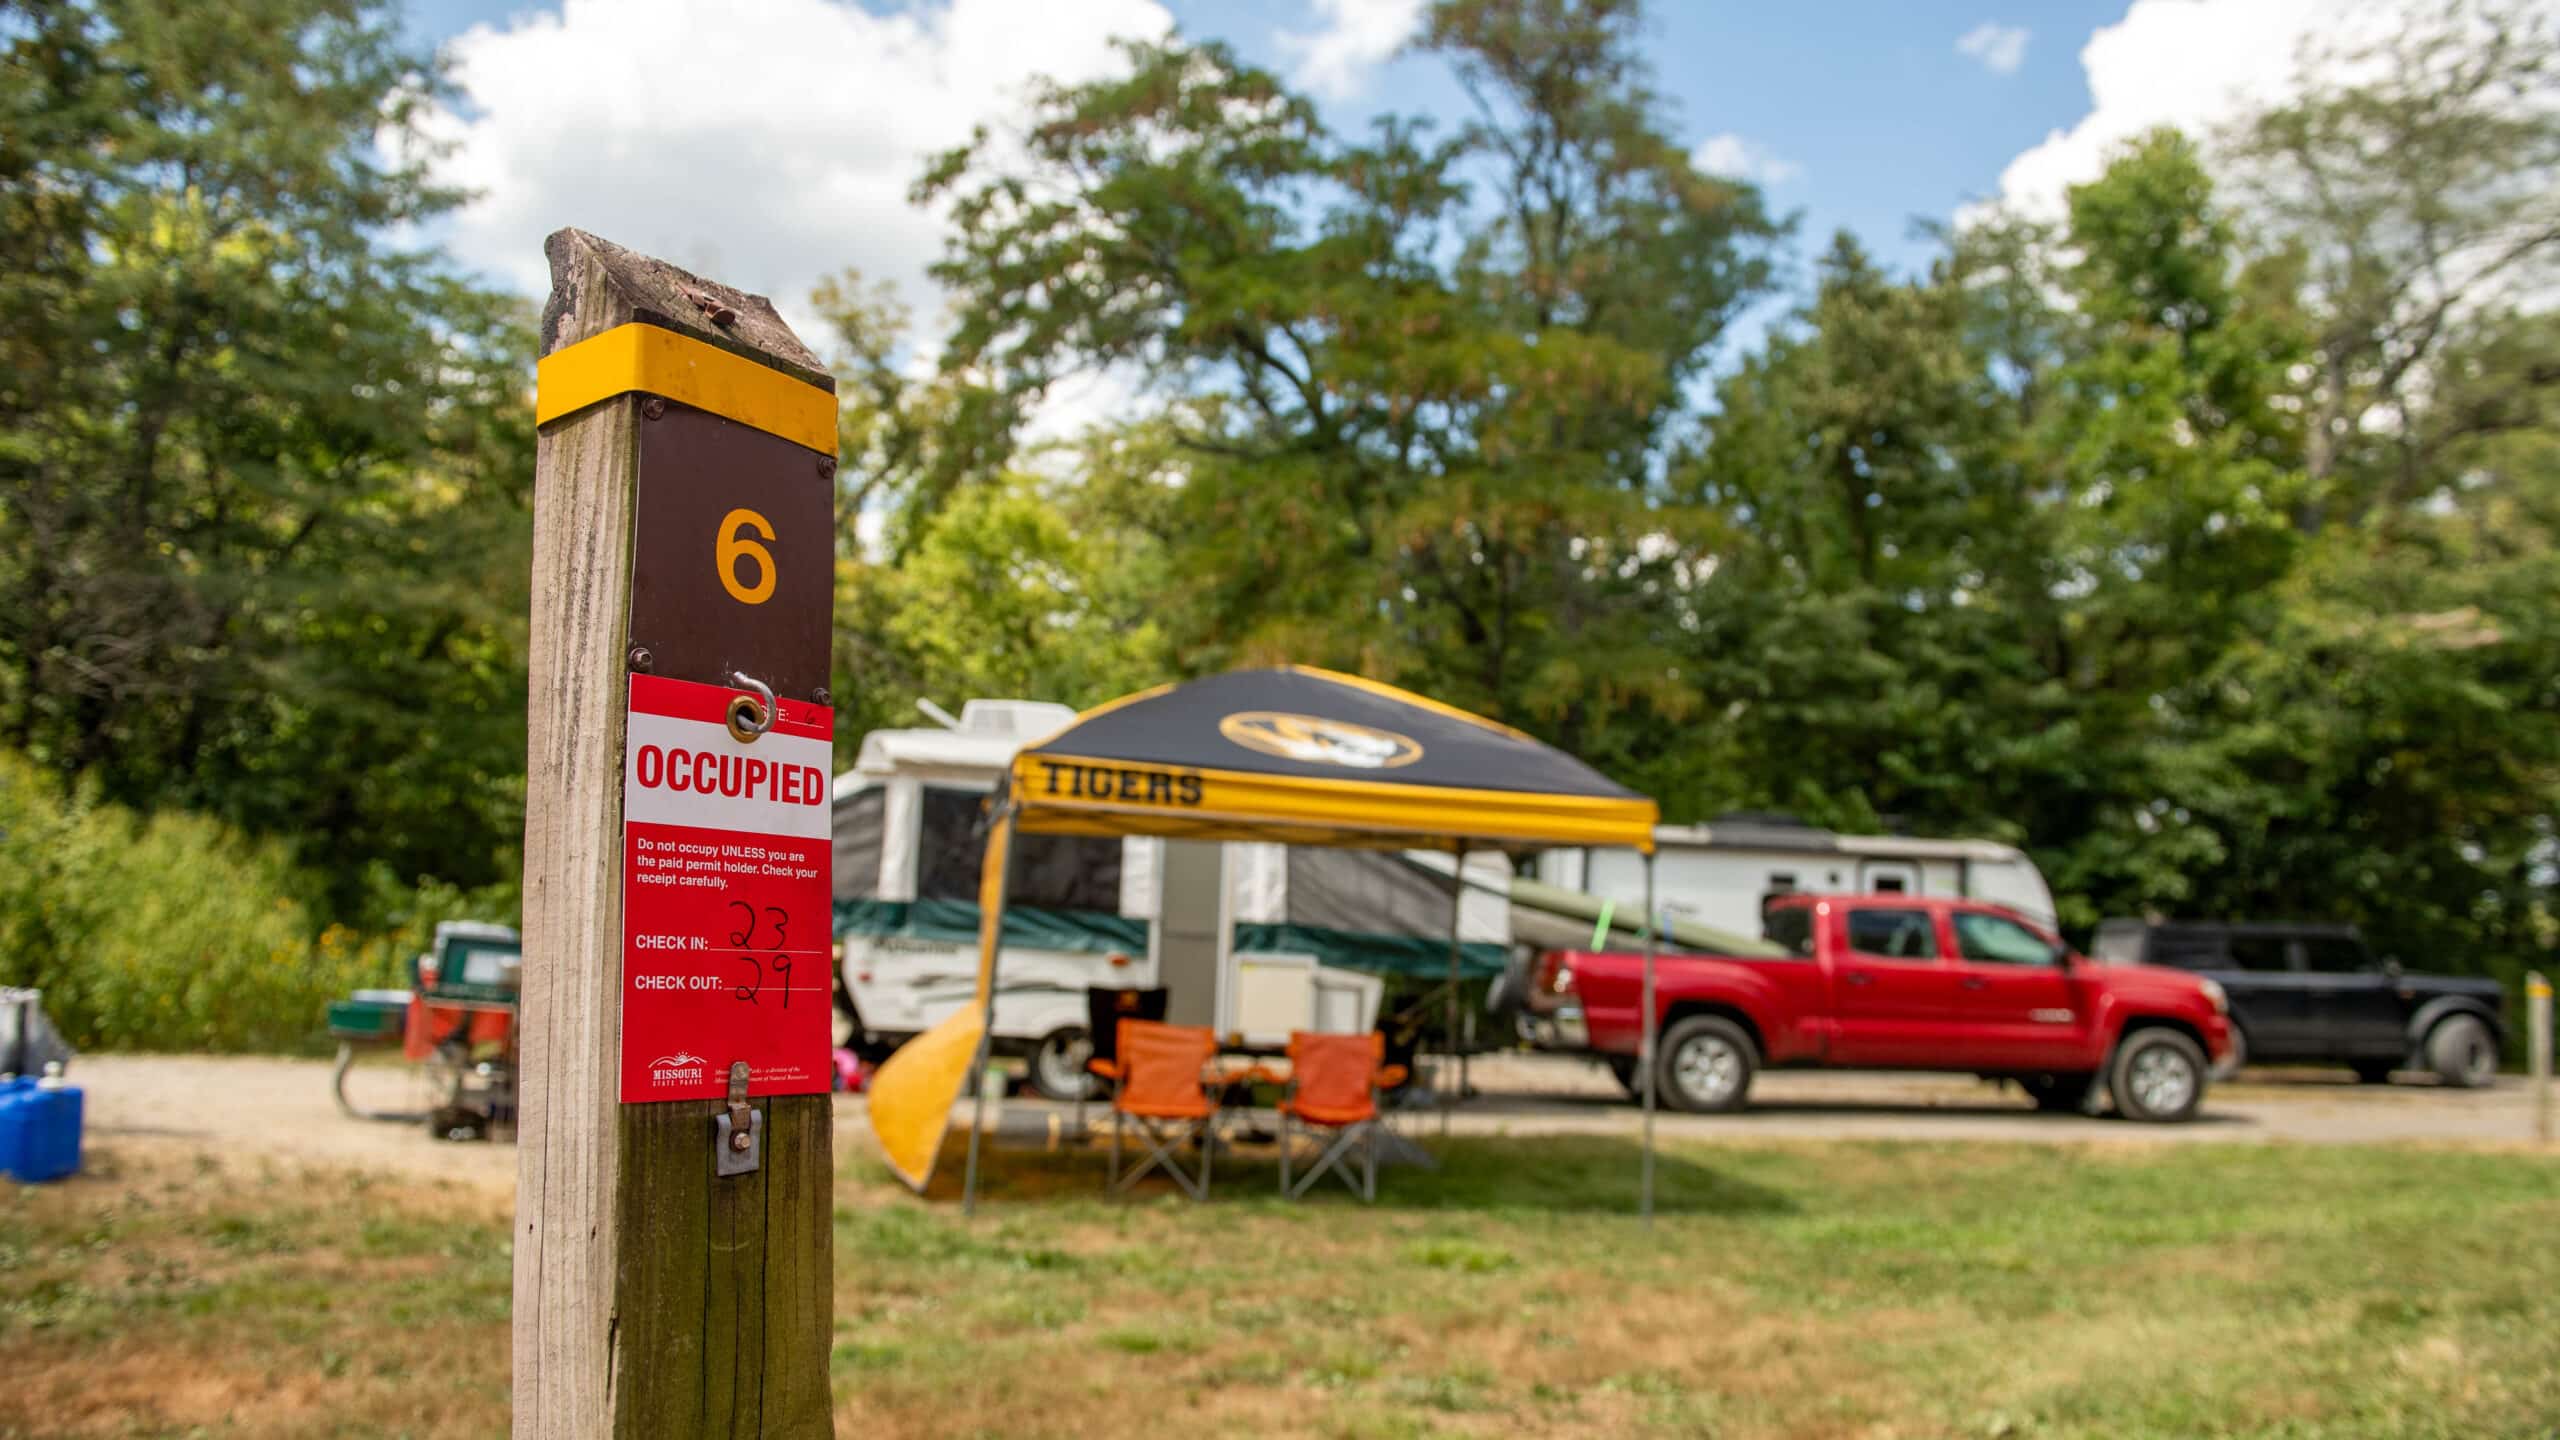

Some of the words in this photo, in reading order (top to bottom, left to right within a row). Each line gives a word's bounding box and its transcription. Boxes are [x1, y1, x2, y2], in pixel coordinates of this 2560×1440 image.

[716, 508, 778, 605] 6
[636, 744, 825, 806] OCCUPIED
[1039, 762, 1203, 806] TIGERS
[637, 838, 655, 851] Do
[657, 840, 676, 853] not
[678, 843, 718, 858] occupy
[721, 845, 766, 859] UNLESS
[768, 850, 787, 862] you
[789, 852, 805, 862] are
[637, 855, 656, 868] the
[658, 857, 683, 872] paid
[686, 859, 721, 874] permit
[723, 862, 760, 875] holder.
[762, 864, 794, 877] Check
[796, 867, 819, 880] your
[636, 873, 677, 888] receipt
[679, 875, 729, 891] carefully.
[729, 900, 789, 951] 23
[635, 934, 688, 950] CHECK
[690, 936, 709, 951] IN:
[634, 975, 686, 990] CHECK
[689, 976, 723, 991] OUT:
[735, 954, 793, 1009] 29
[653, 1068, 703, 1080] MISSOURI
